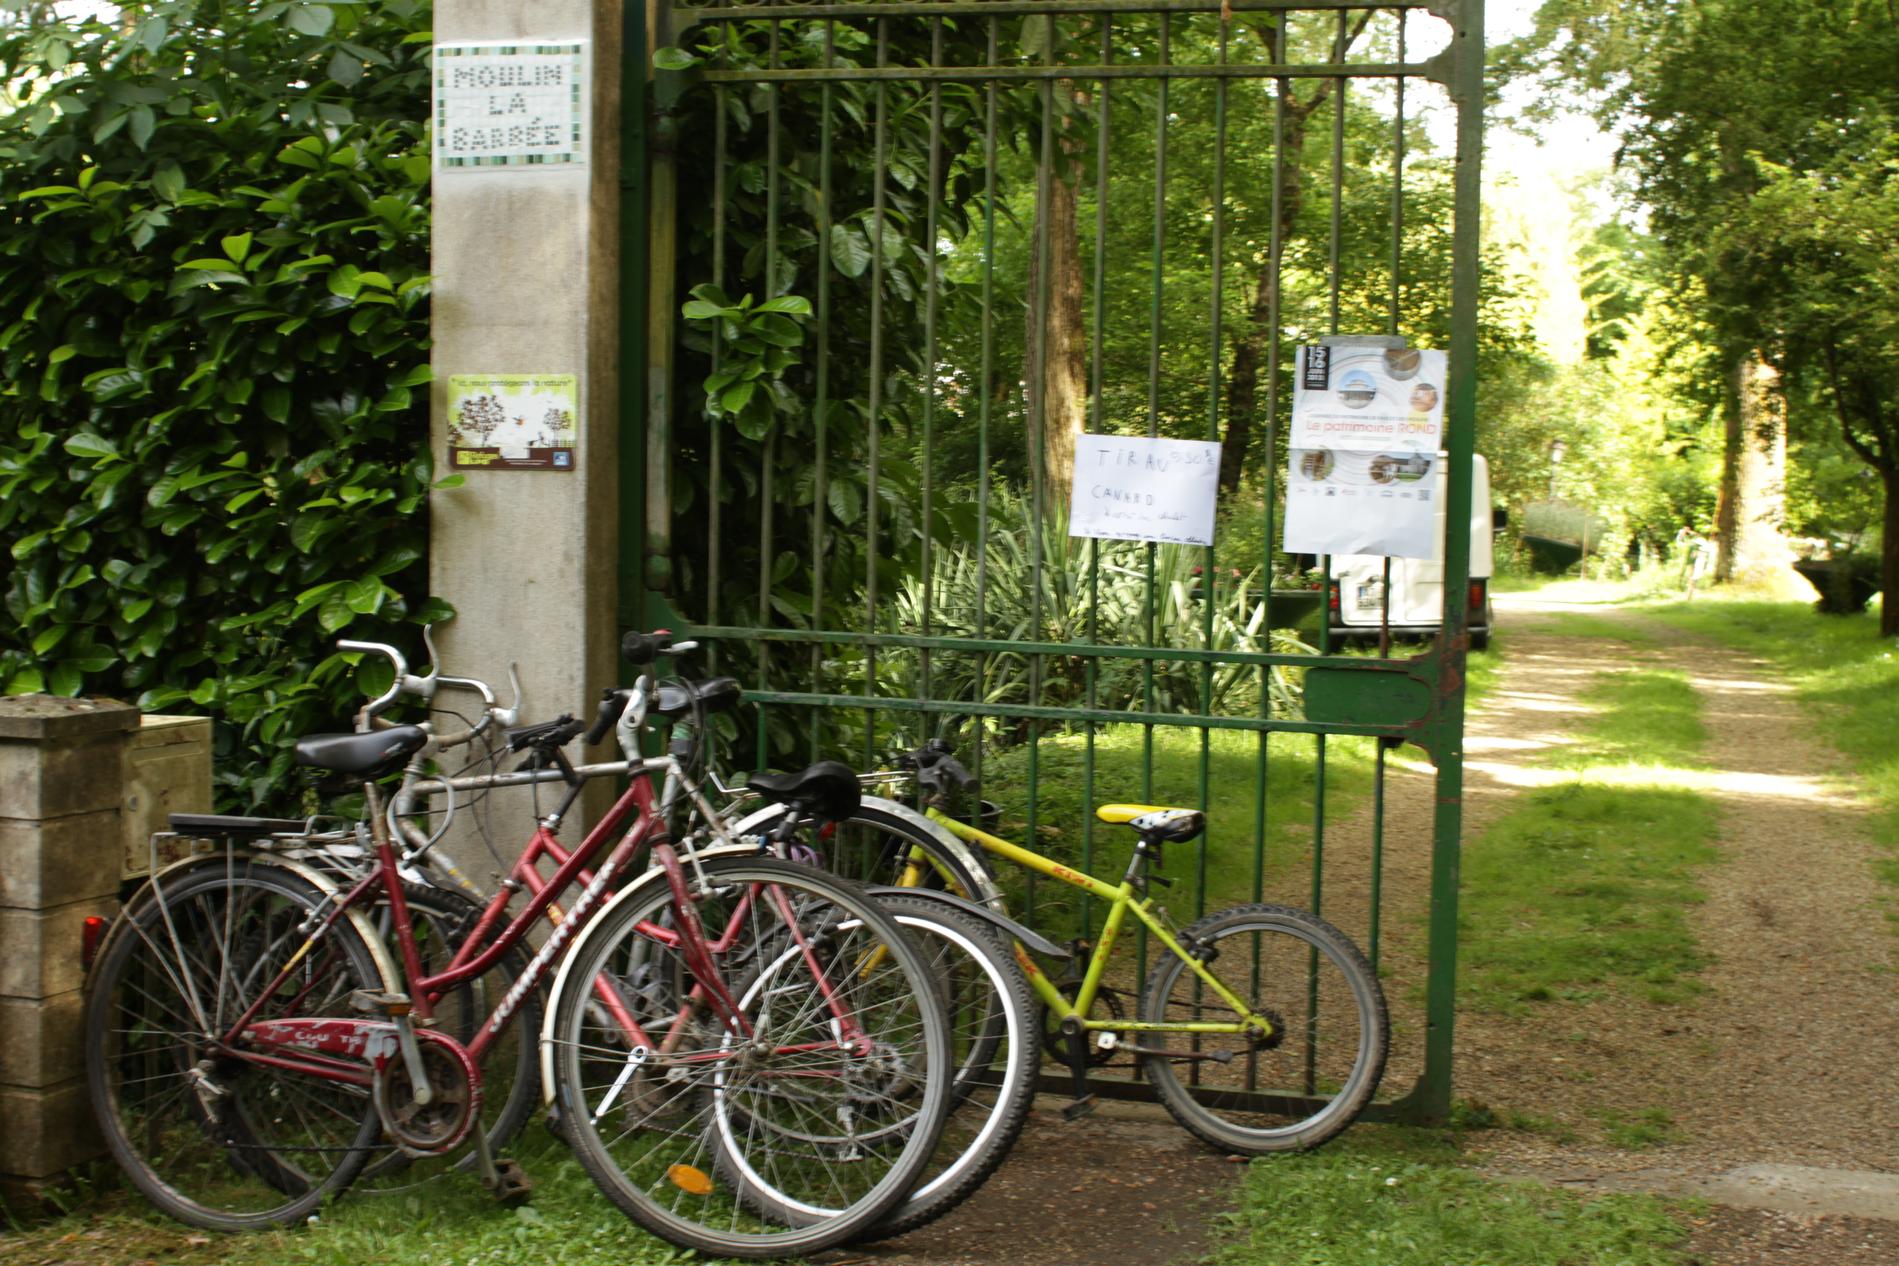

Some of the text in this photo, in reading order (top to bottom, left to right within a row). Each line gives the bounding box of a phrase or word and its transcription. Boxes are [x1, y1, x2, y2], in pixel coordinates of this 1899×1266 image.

[453, 65, 562, 88] MOULIN
[489, 93, 527, 115] LA
[1307, 346, 1327, 358] 15
[1306, 420, 1320, 431] Le
[1323, 422, 1393, 434] patrimoine
